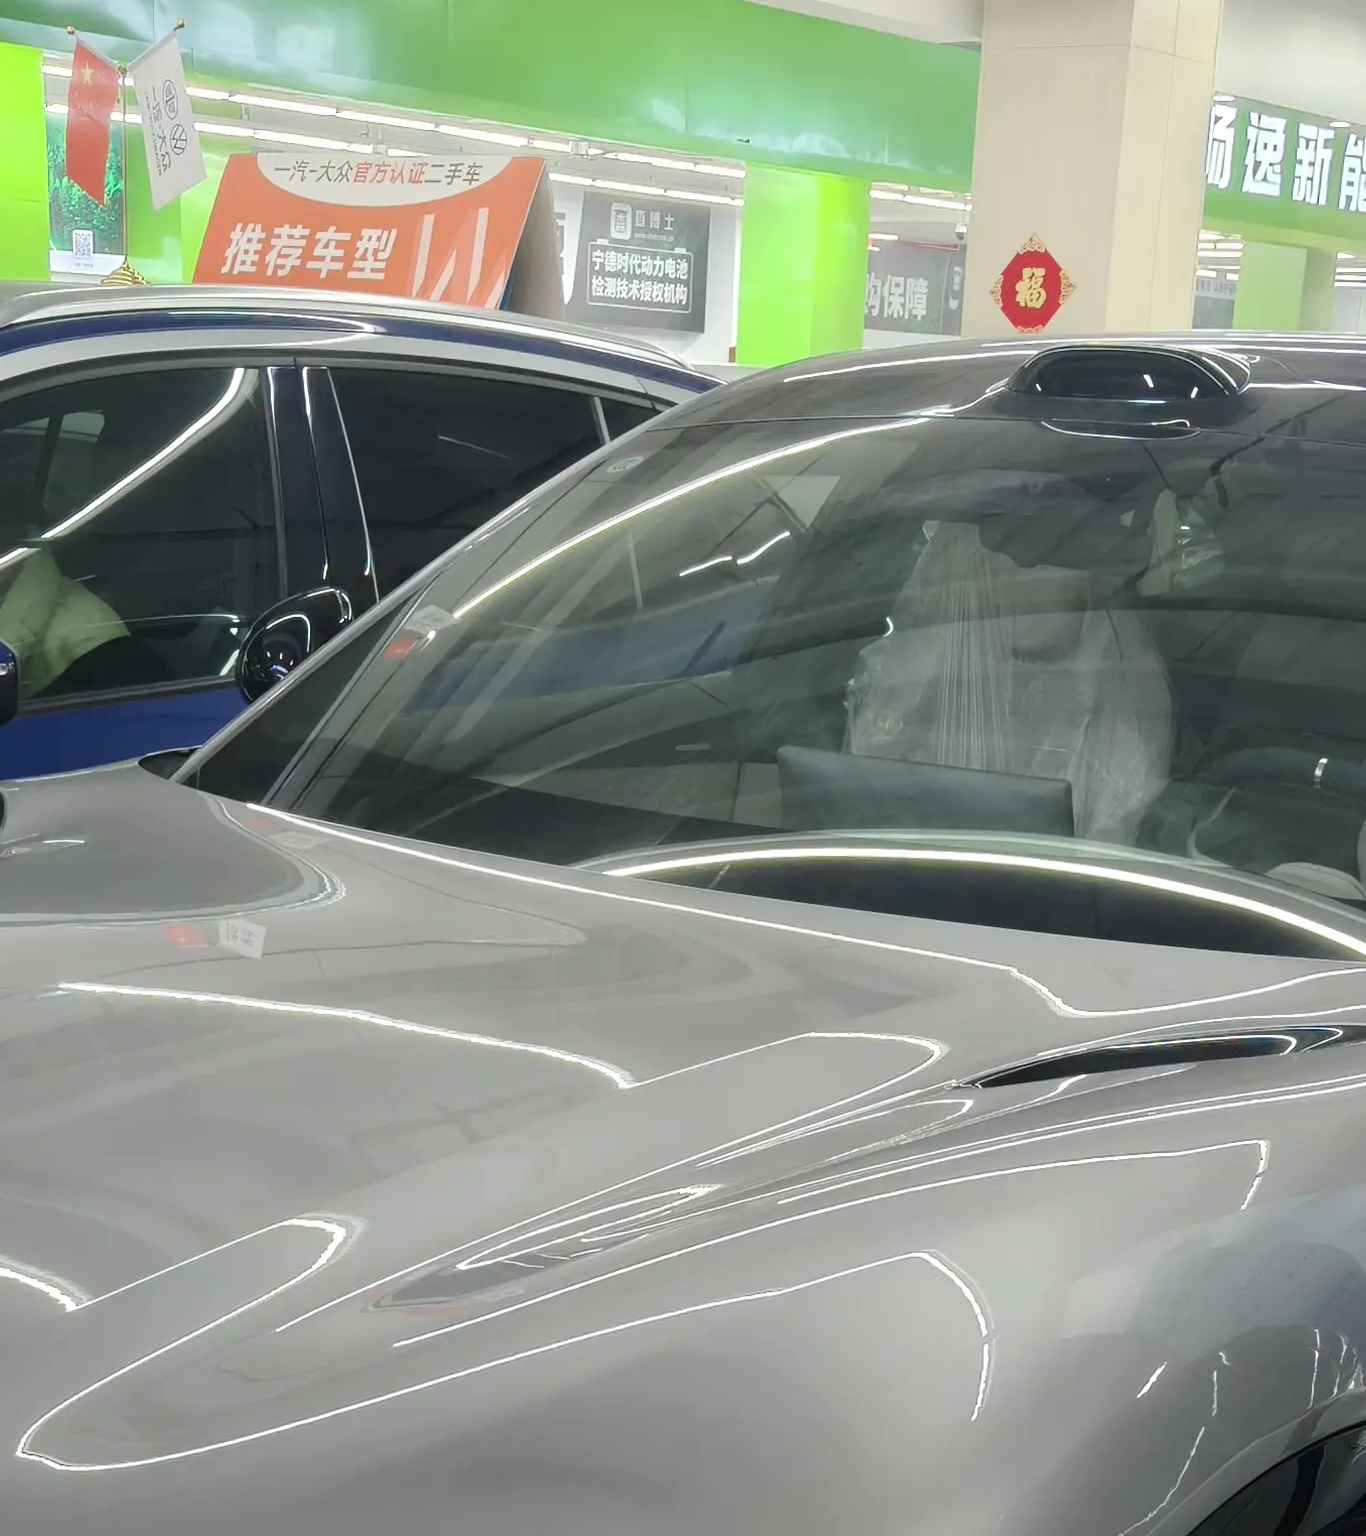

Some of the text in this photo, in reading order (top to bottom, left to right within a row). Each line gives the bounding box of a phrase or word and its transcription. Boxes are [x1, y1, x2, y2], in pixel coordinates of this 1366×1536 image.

[274, 159, 484, 186] 一汽-大众官方认证二手车
[220, 222, 398, 280] 推荐车型
[591, 250, 688, 280] 宁德时代动力电池
[591, 275, 688, 305] 检测技术授权机构
[1015, 267, 1047, 310] 福
